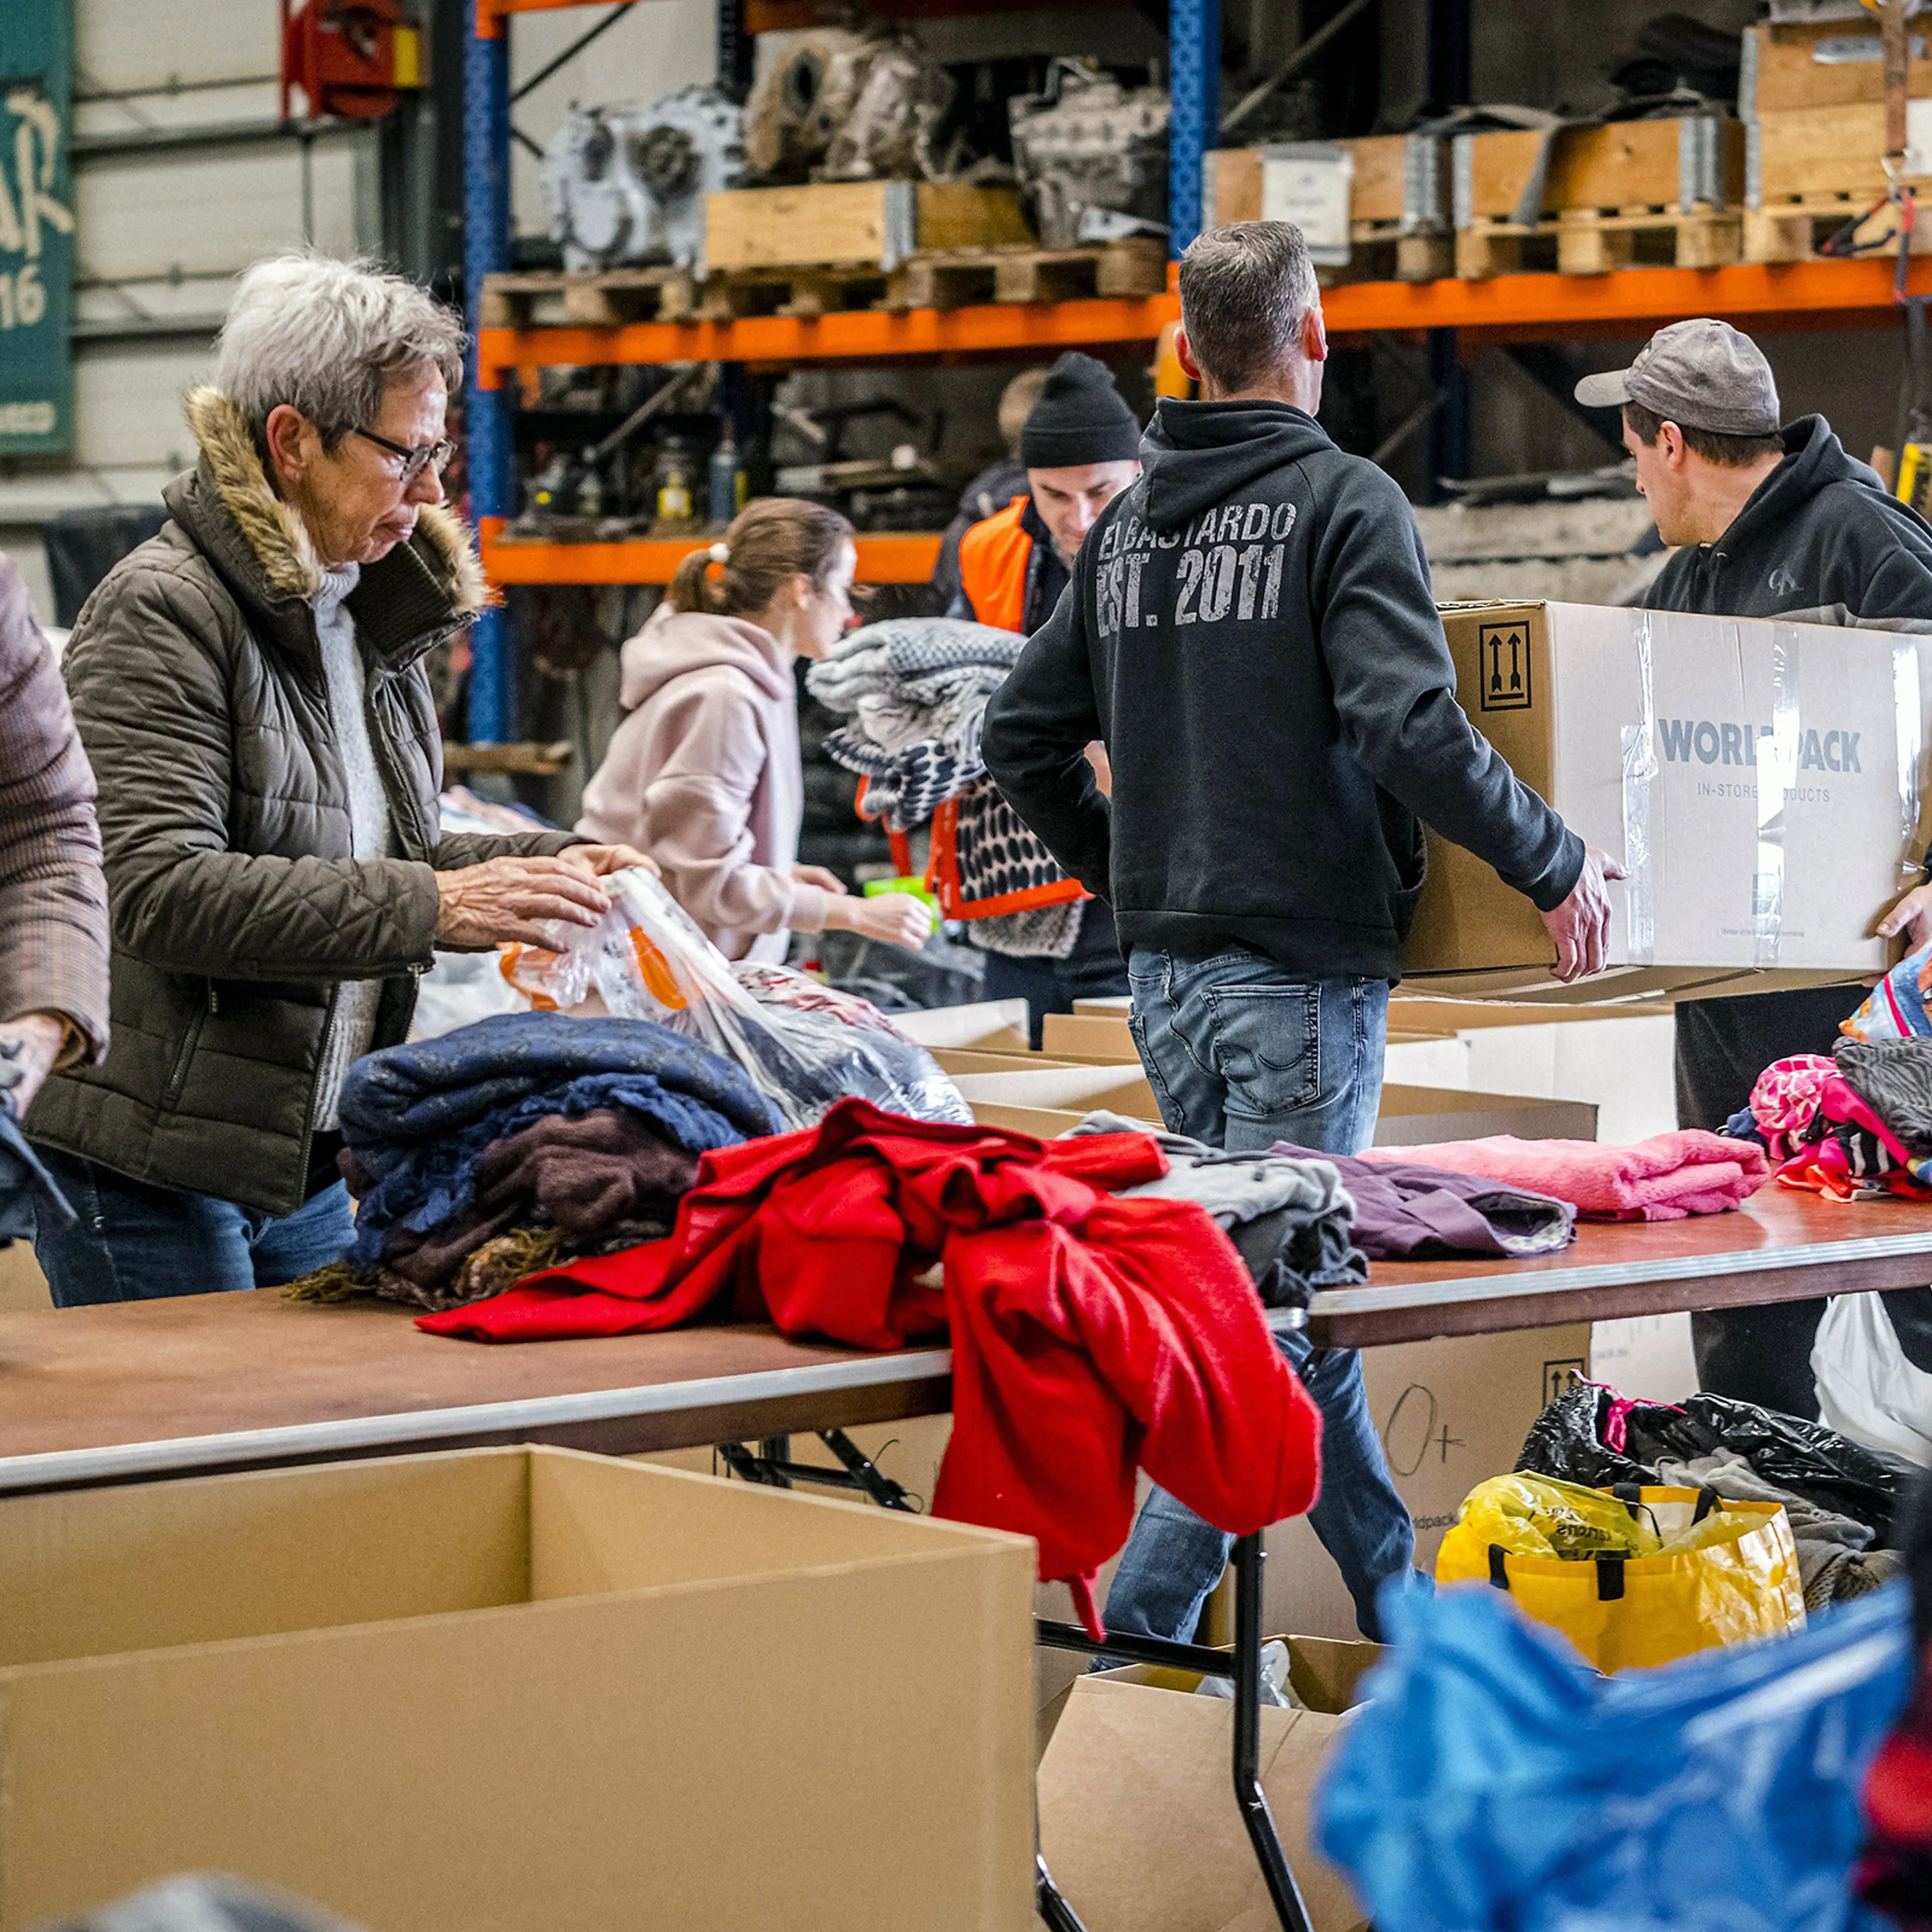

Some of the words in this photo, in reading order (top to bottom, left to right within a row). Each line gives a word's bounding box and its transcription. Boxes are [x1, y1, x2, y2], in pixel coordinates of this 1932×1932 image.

[1096, 552, 1158, 638] EST.
[1174, 543, 1285, 626] 2011
[1658, 718, 1862, 773] WORLACK
